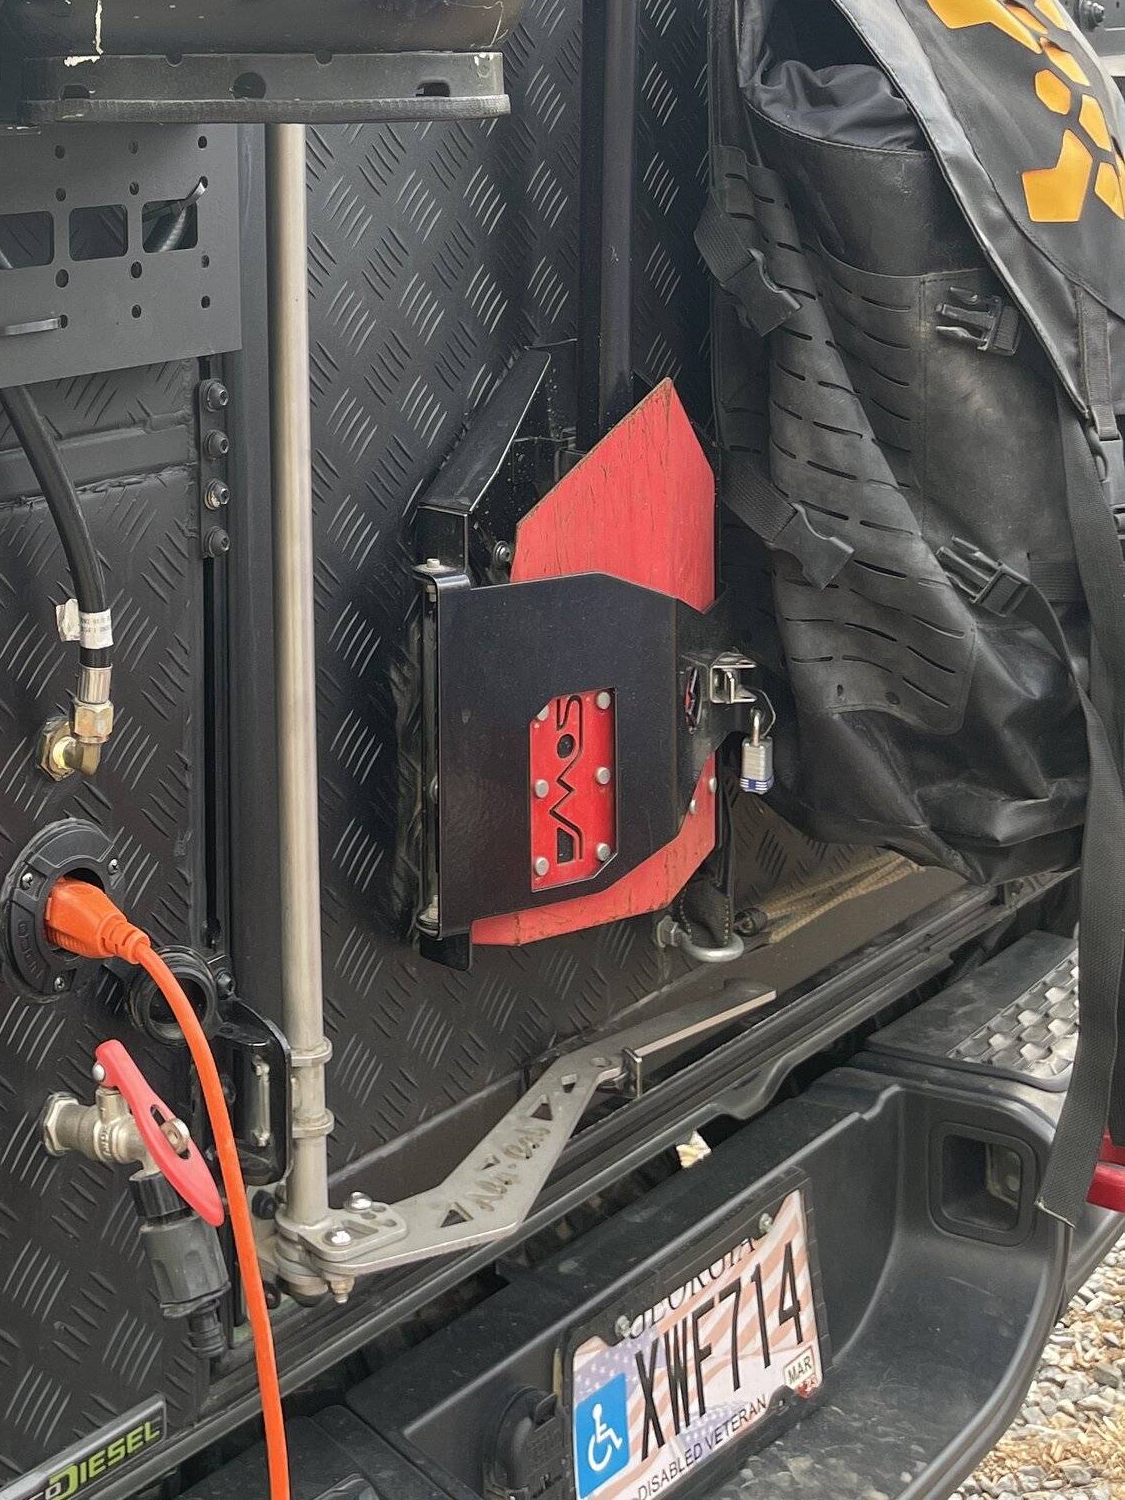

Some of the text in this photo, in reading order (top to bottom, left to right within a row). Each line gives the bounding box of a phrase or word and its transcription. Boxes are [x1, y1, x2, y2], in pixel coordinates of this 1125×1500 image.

[549, 694, 584, 865] DMOS
[635, 1241, 803, 1463] XWF714
[787, 1355, 812, 1385] MAR
[637, 1393, 768, 1500] DISABLED VETERAN
